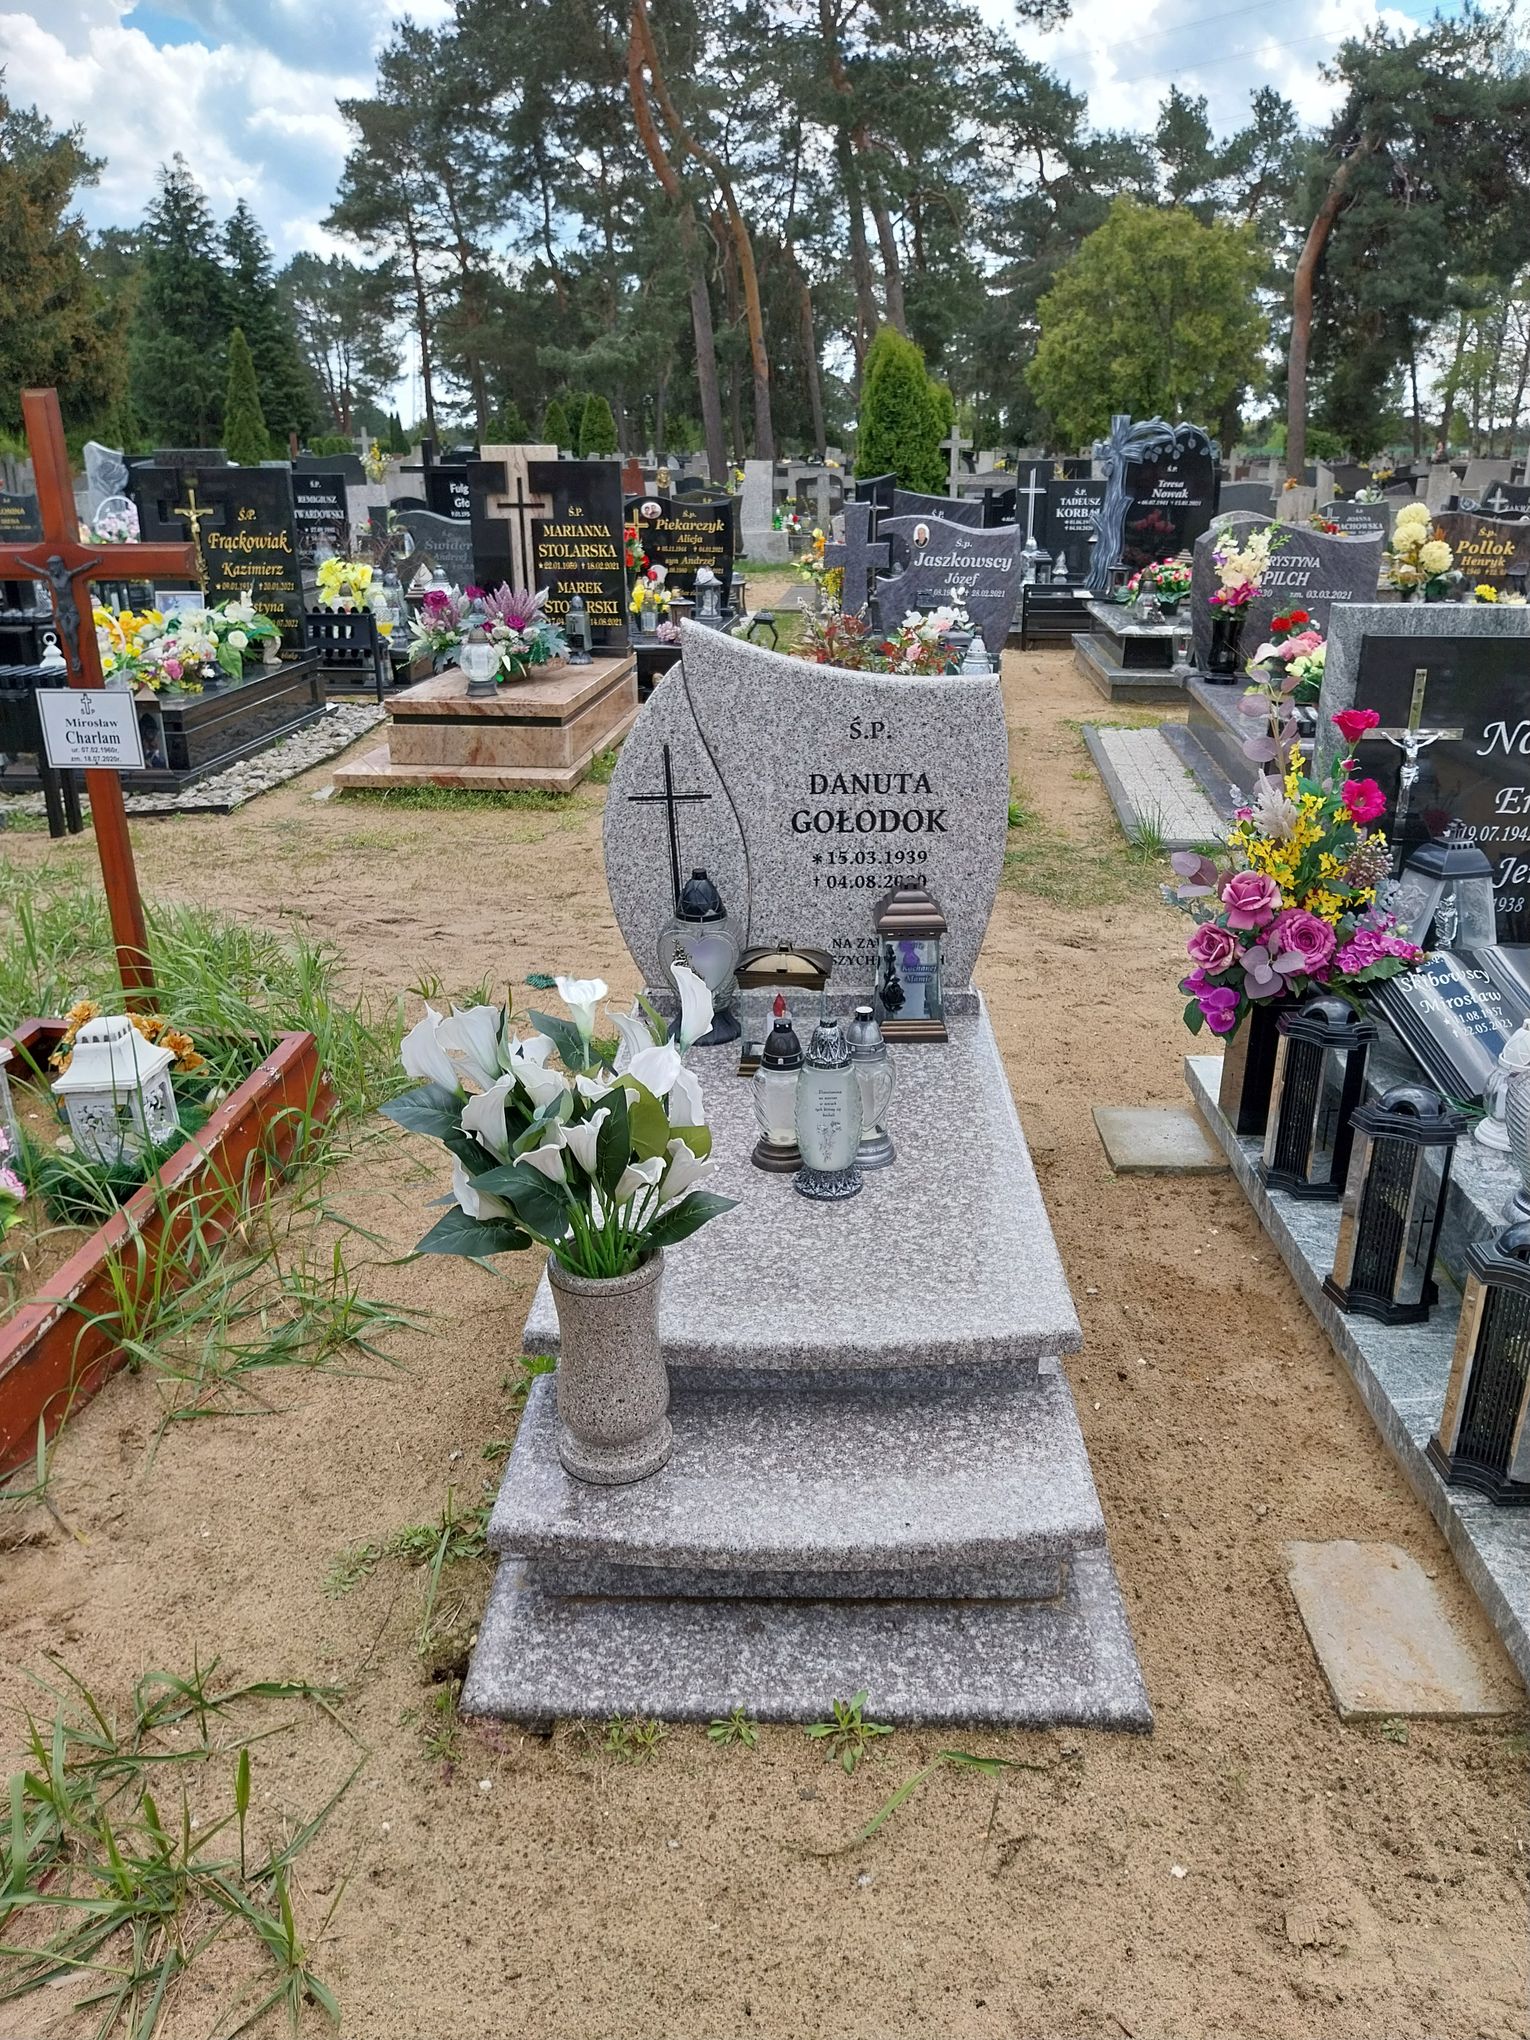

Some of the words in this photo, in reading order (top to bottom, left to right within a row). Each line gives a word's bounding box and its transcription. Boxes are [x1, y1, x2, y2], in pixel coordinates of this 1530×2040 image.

[1158, 480, 1185, 488] Teresa
[297, 495, 337, 504] REMIGIUSZ
[1151, 488, 1189, 499] Nowak
[1060, 497, 1101, 506] TADEUSZ
[293, 509, 345, 519] TWARDOWSKI
[567, 505, 585, 517] Ś.P.
[543, 524, 611, 537] MARIANNA
[655, 518, 726, 534] Piekarczyk
[208, 530, 292, 554] Frąckowiak
[677, 534, 704, 544] Alicja
[955, 538, 973, 549] Ś.p.
[538, 543, 618, 558] STOLARSKA
[1455, 540, 1516, 555] Pollok
[681, 556, 716, 566] Andrzej
[914, 552, 1013, 572] Jaszkowscy
[1268, 555, 1321, 568] RYSTYNA
[1461, 556, 1506, 569] Henryk
[222, 561, 284, 578] Kazimierz
[944, 572, 981, 587] Józef
[1261, 571, 1311, 586] PILCH
[557, 581, 604, 594] MAREK
[1305, 590, 1353, 600] 03.03.2021
[544, 600, 619, 614] STORSKI
[849, 716, 892, 740] Ś.P.
[809, 772, 932, 795] DANUTA
[791, 809, 948, 834] GOŁODOK
[827, 850, 928, 865] 15.03.1939
[826, 874, 927, 889] 04.08.200
[832, 938, 852, 949] NA
[857, 938, 880, 949] ZA
[905, 975, 932, 984] Mamie
[1400, 968, 1491, 993] Skibowscy
[1419, 987, 1502, 1014] Mirosław
[1454, 1006, 1503, 1025] 11.08.1957
[1463, 1018, 1513, 1036] 22.05.2023
